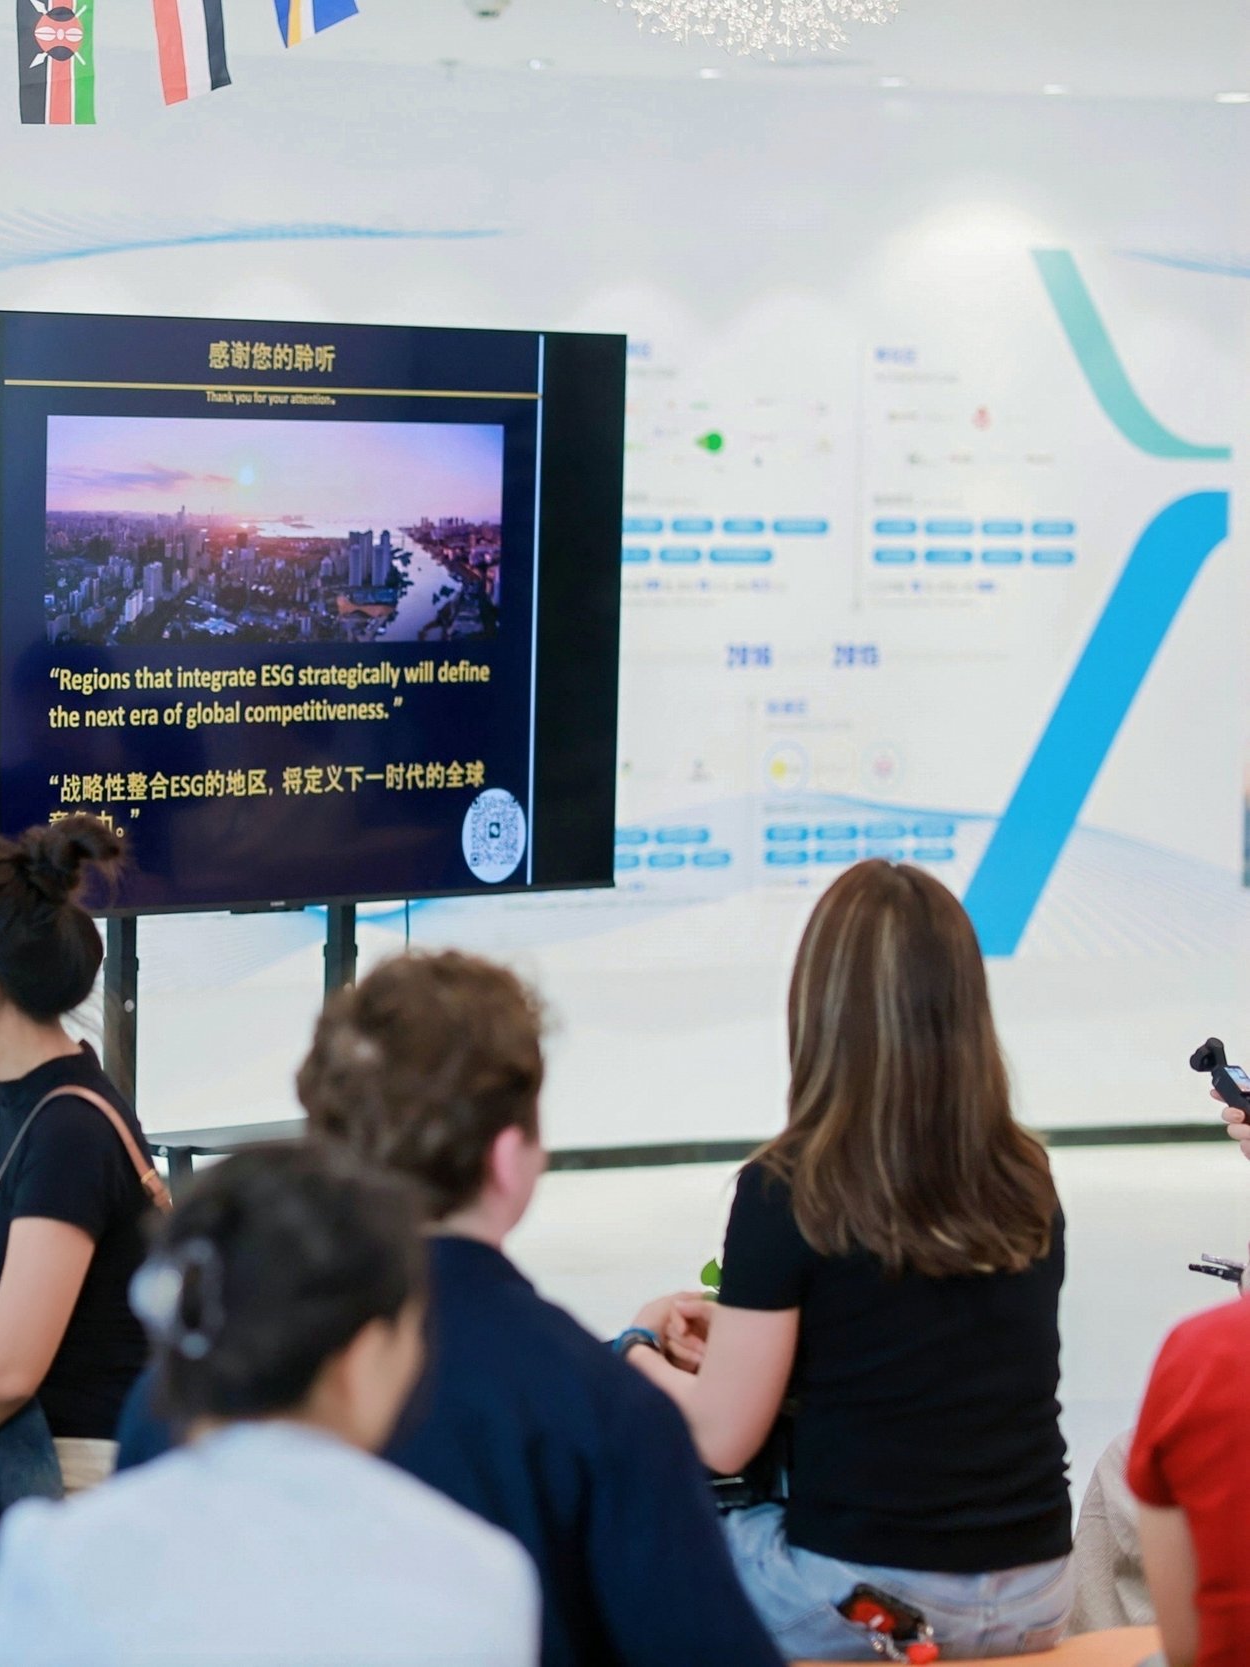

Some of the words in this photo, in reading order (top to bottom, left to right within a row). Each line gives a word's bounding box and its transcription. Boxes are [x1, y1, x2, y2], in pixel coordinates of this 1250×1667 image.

[208, 340, 336, 372] 感谢您的聆听
[206, 391, 234, 403] Thank
[235, 393, 252, 405] you
[253, 392, 267, 404] for
[268, 394, 289, 406] your
[49, 667, 130, 695] “Regions
[134, 666, 173, 689] that
[177, 666, 257, 692] integrate
[261, 664, 295, 687] ESG
[298, 661, 401, 689] strategically
[404, 660, 435, 684] will
[437, 660, 491, 684] define
[49, 705, 80, 728] the
[85, 706, 126, 728] next
[129, 708, 159, 726] era
[163, 702, 184, 725] of
[186, 701, 240, 730] global
